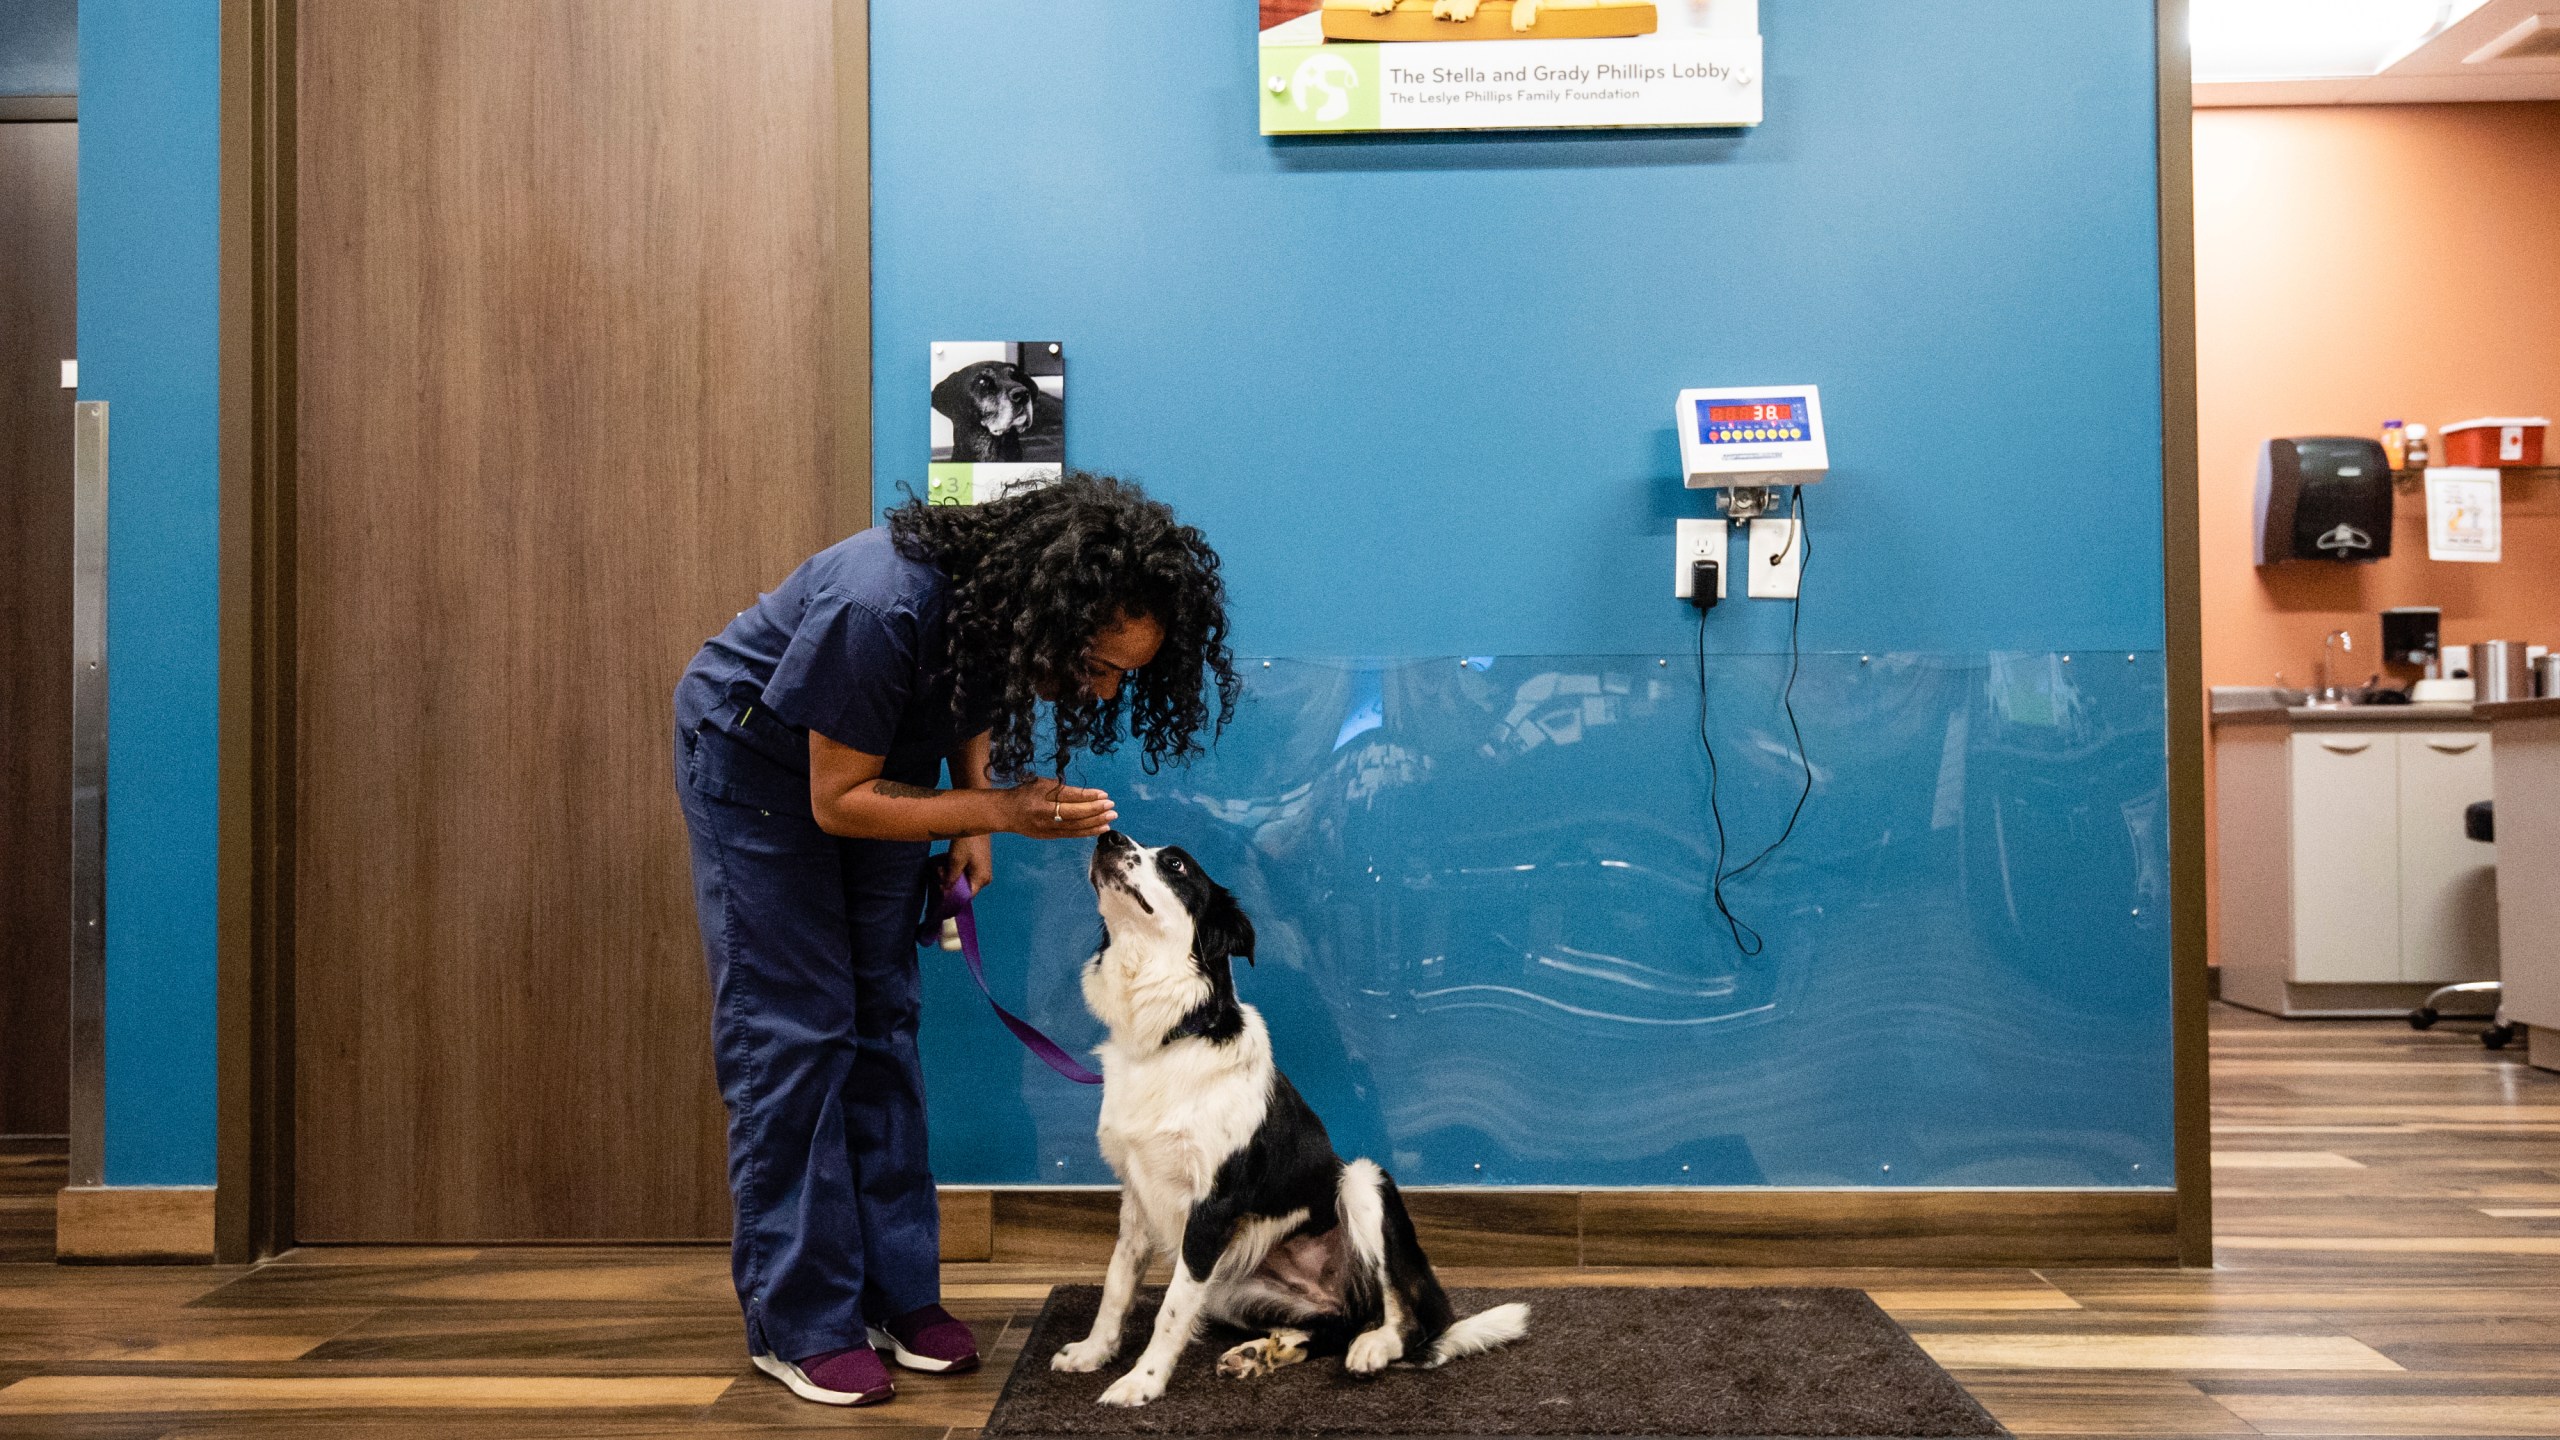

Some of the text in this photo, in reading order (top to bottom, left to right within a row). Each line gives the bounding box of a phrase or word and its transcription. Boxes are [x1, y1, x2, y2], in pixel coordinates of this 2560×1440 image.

[1389, 63, 1730, 84] The Stella and Grady Phillips Lobby
[1389, 88, 1640, 105] The Leslye Phillips Family Foundation
